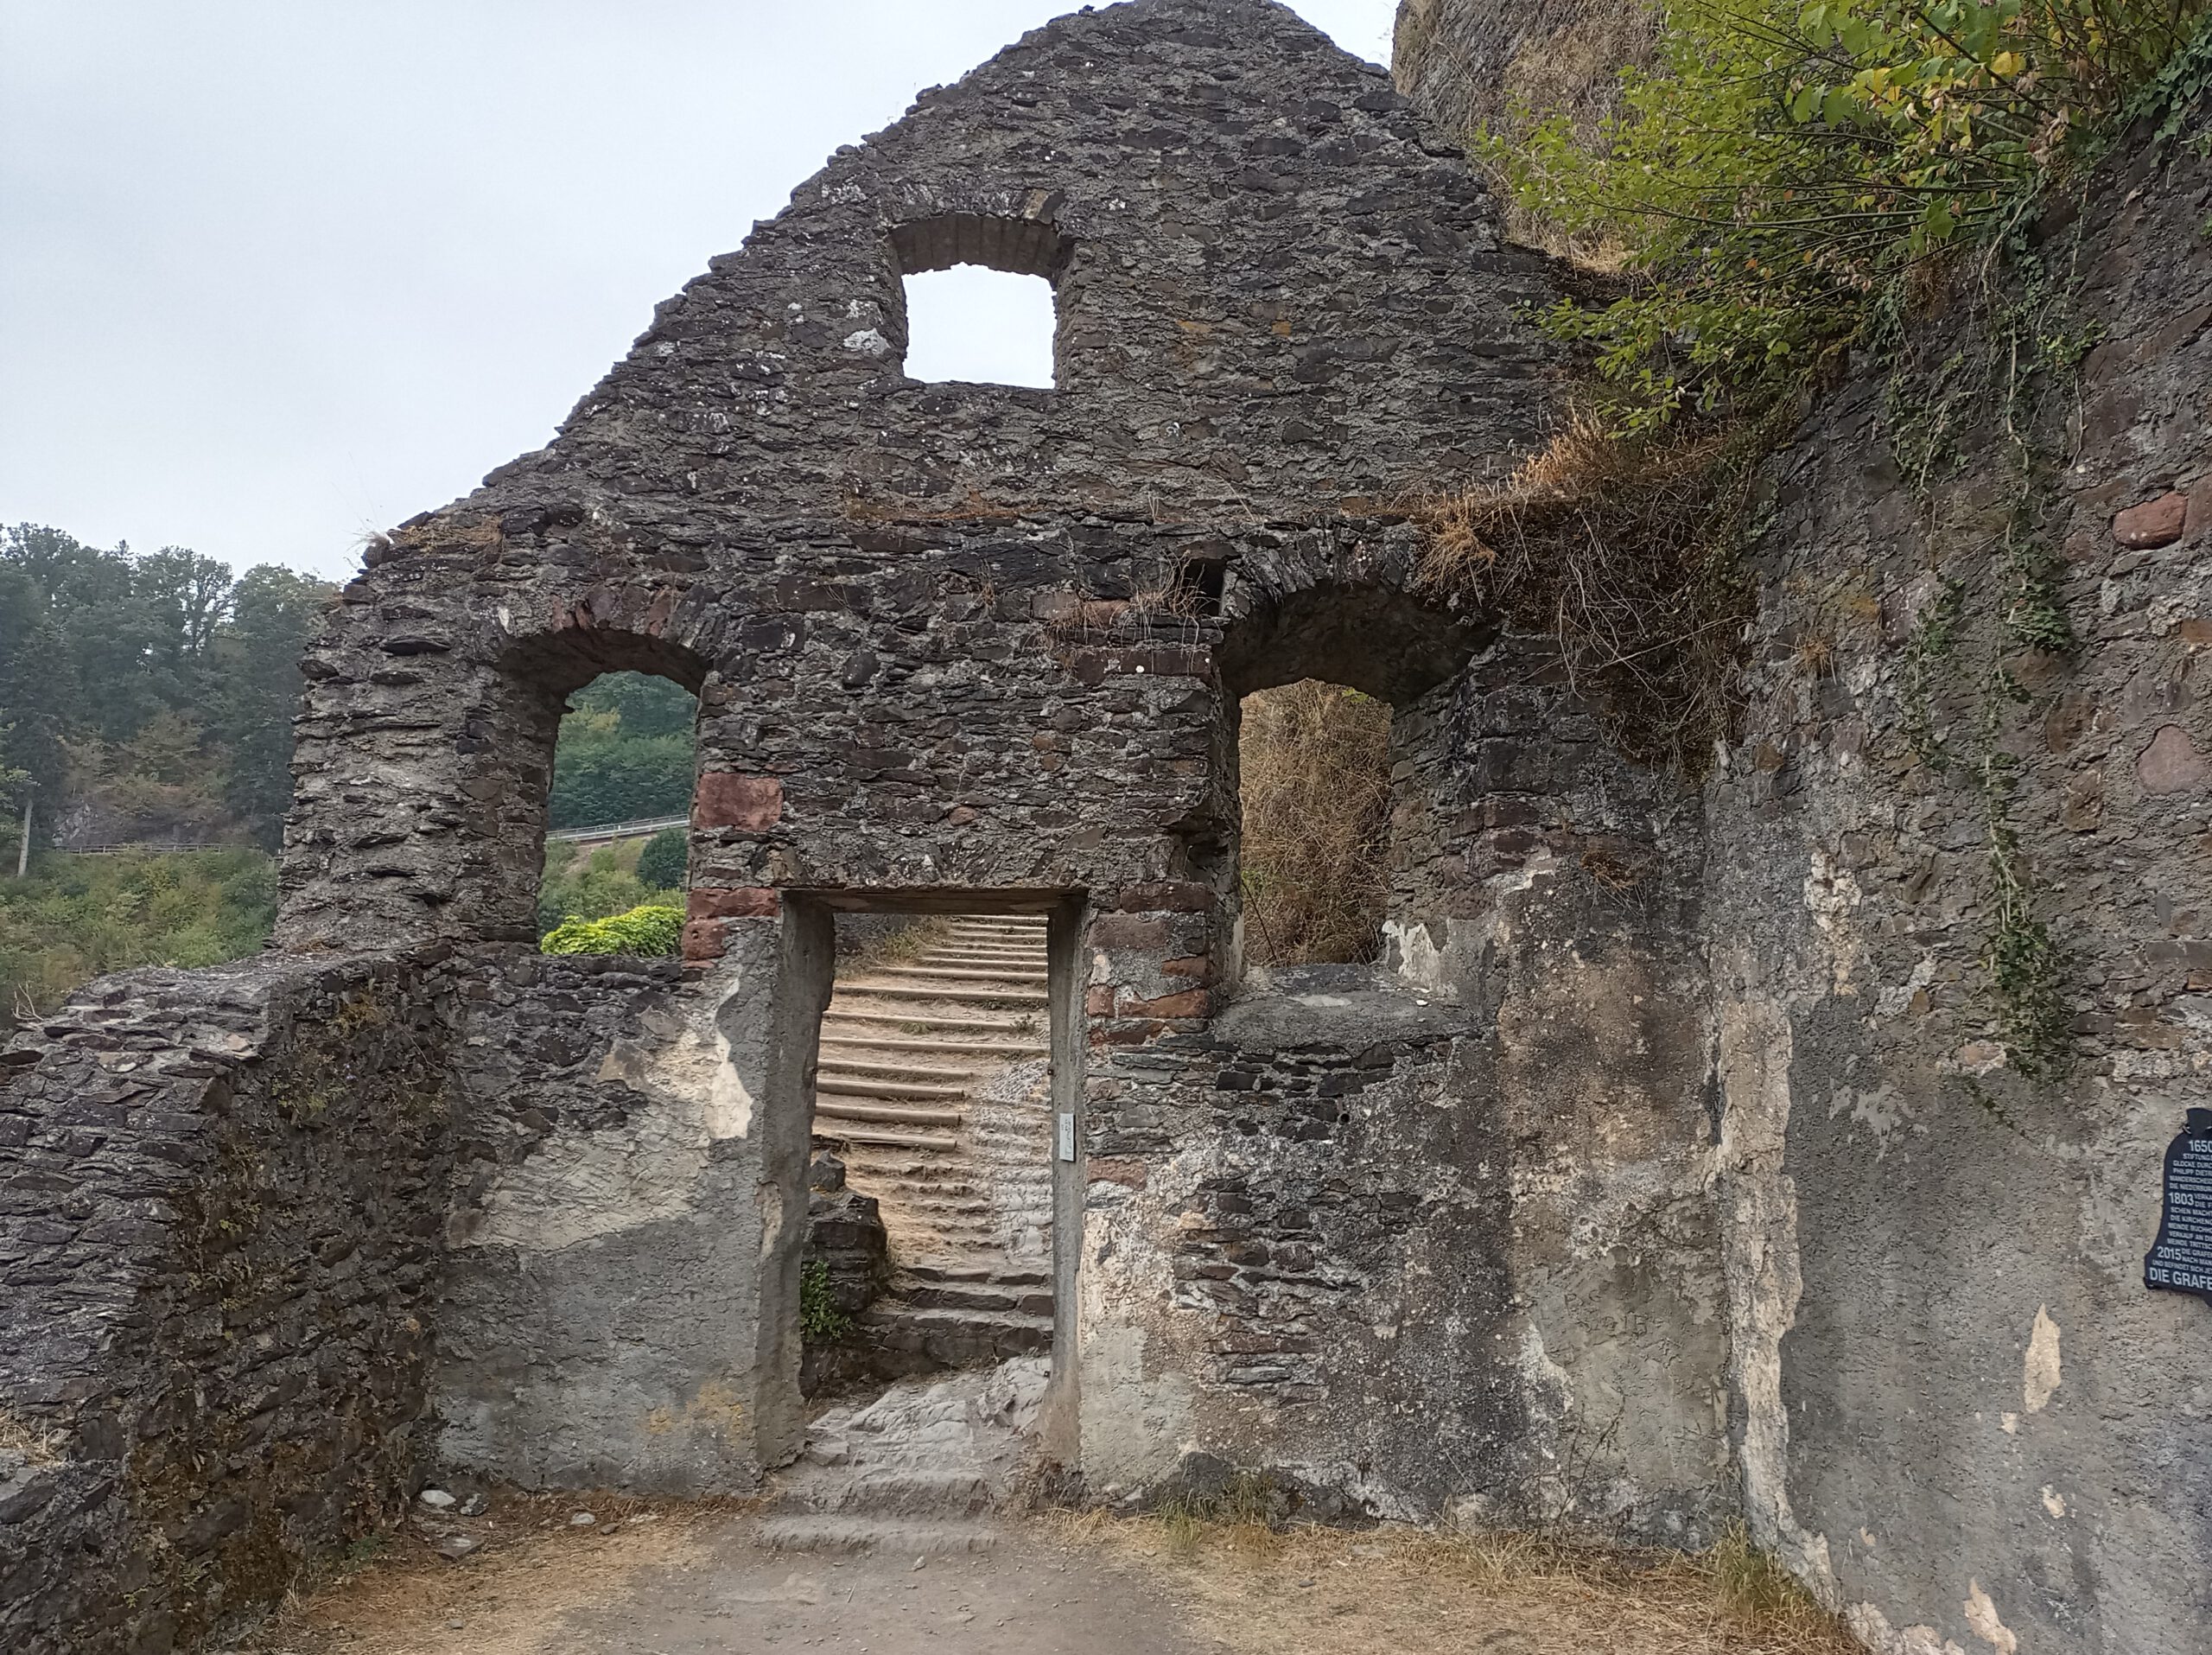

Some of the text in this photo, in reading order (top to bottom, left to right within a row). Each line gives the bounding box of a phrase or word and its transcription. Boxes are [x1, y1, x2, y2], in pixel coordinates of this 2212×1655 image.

[2168, 1192, 2194, 1206] 1803
[2168, 1222, 2189, 1231] MEINDE
[2169, 1231, 2193, 1239] VERKAUF
[2167, 1238, 2188, 1246] MEINDE
[2157, 1245, 2182, 1261] 2015
[2183, 1256, 2198, 1264] NACH
[2164, 1261, 2189, 1271] BEFINDET
[2149, 1267, 2212, 1291] DIE GRAFE
